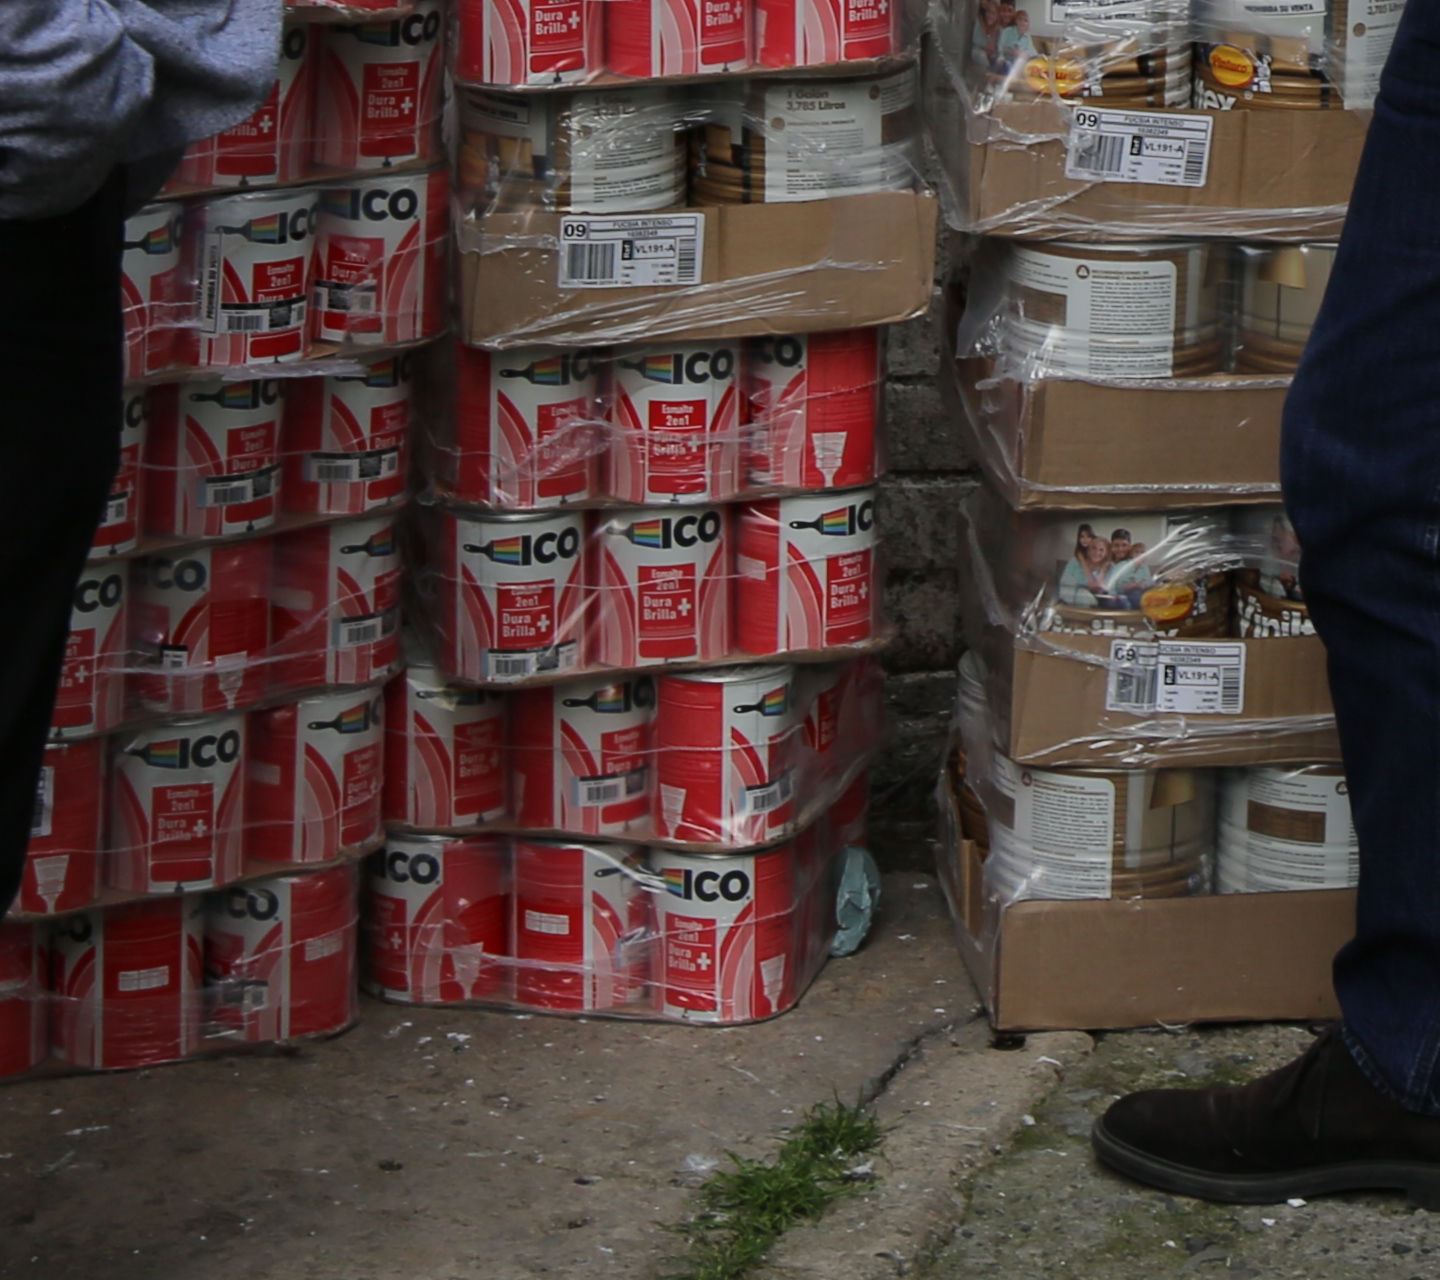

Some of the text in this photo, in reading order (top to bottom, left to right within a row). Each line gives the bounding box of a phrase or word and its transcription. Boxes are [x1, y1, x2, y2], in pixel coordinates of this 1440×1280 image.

[705, 2, 731, 14] Dura
[1291, 3, 1314, 11] VENTA
[534, 10, 563, 22] Dura
[705, 14, 734, 27] Brilla
[849, 8, 878, 22] Brilla
[390, 10, 441, 47] ICO
[534, 22, 568, 35] Brilla
[381, 76, 404, 89] 2en1
[368, 94, 396, 106] Dura
[786, 100, 846, 111] 3,785 Litros
[367, 107, 399, 119] Brilla
[1076, 112, 1098, 127] 09
[1152, 119, 1185, 128] INTENSO
[1144, 142, 1184, 153] VL191-A
[351, 188, 418, 221] ICO
[640, 219, 673, 227] INTENSO
[564, 223, 586, 238] 09
[634, 244, 676, 254] VL191-A
[267, 264, 295, 276] Esmalte
[270, 275, 292, 288] 2en1
[672, 348, 734, 385] ICO
[661, 403, 695, 415] Esmalte
[665, 414, 690, 427] 2en1
[661, 510, 721, 549] ICO
[521, 526, 580, 566] ICO
[651, 568, 684, 579] Esmalte
[74, 573, 123, 613] CO
[830, 583, 856, 596] Dura
[515, 595, 539, 608] 2en1
[643, 595, 672, 608] Dura
[830, 595, 859, 609] Brilla
[502, 614, 532, 625] Dura
[643, 608, 677, 621] Brilla
[502, 625, 536, 638] Brilla
[1178, 671, 1218, 681] VL191-A
[178, 729, 240, 769] ICO
[460, 753, 486, 766] Dura
[460, 765, 490, 778] Brilla
[157, 817, 187, 829] Dura
[683, 869, 750, 902] ICO
[668, 942, 692, 958] Dura
[668, 955, 697, 972] Brilla
